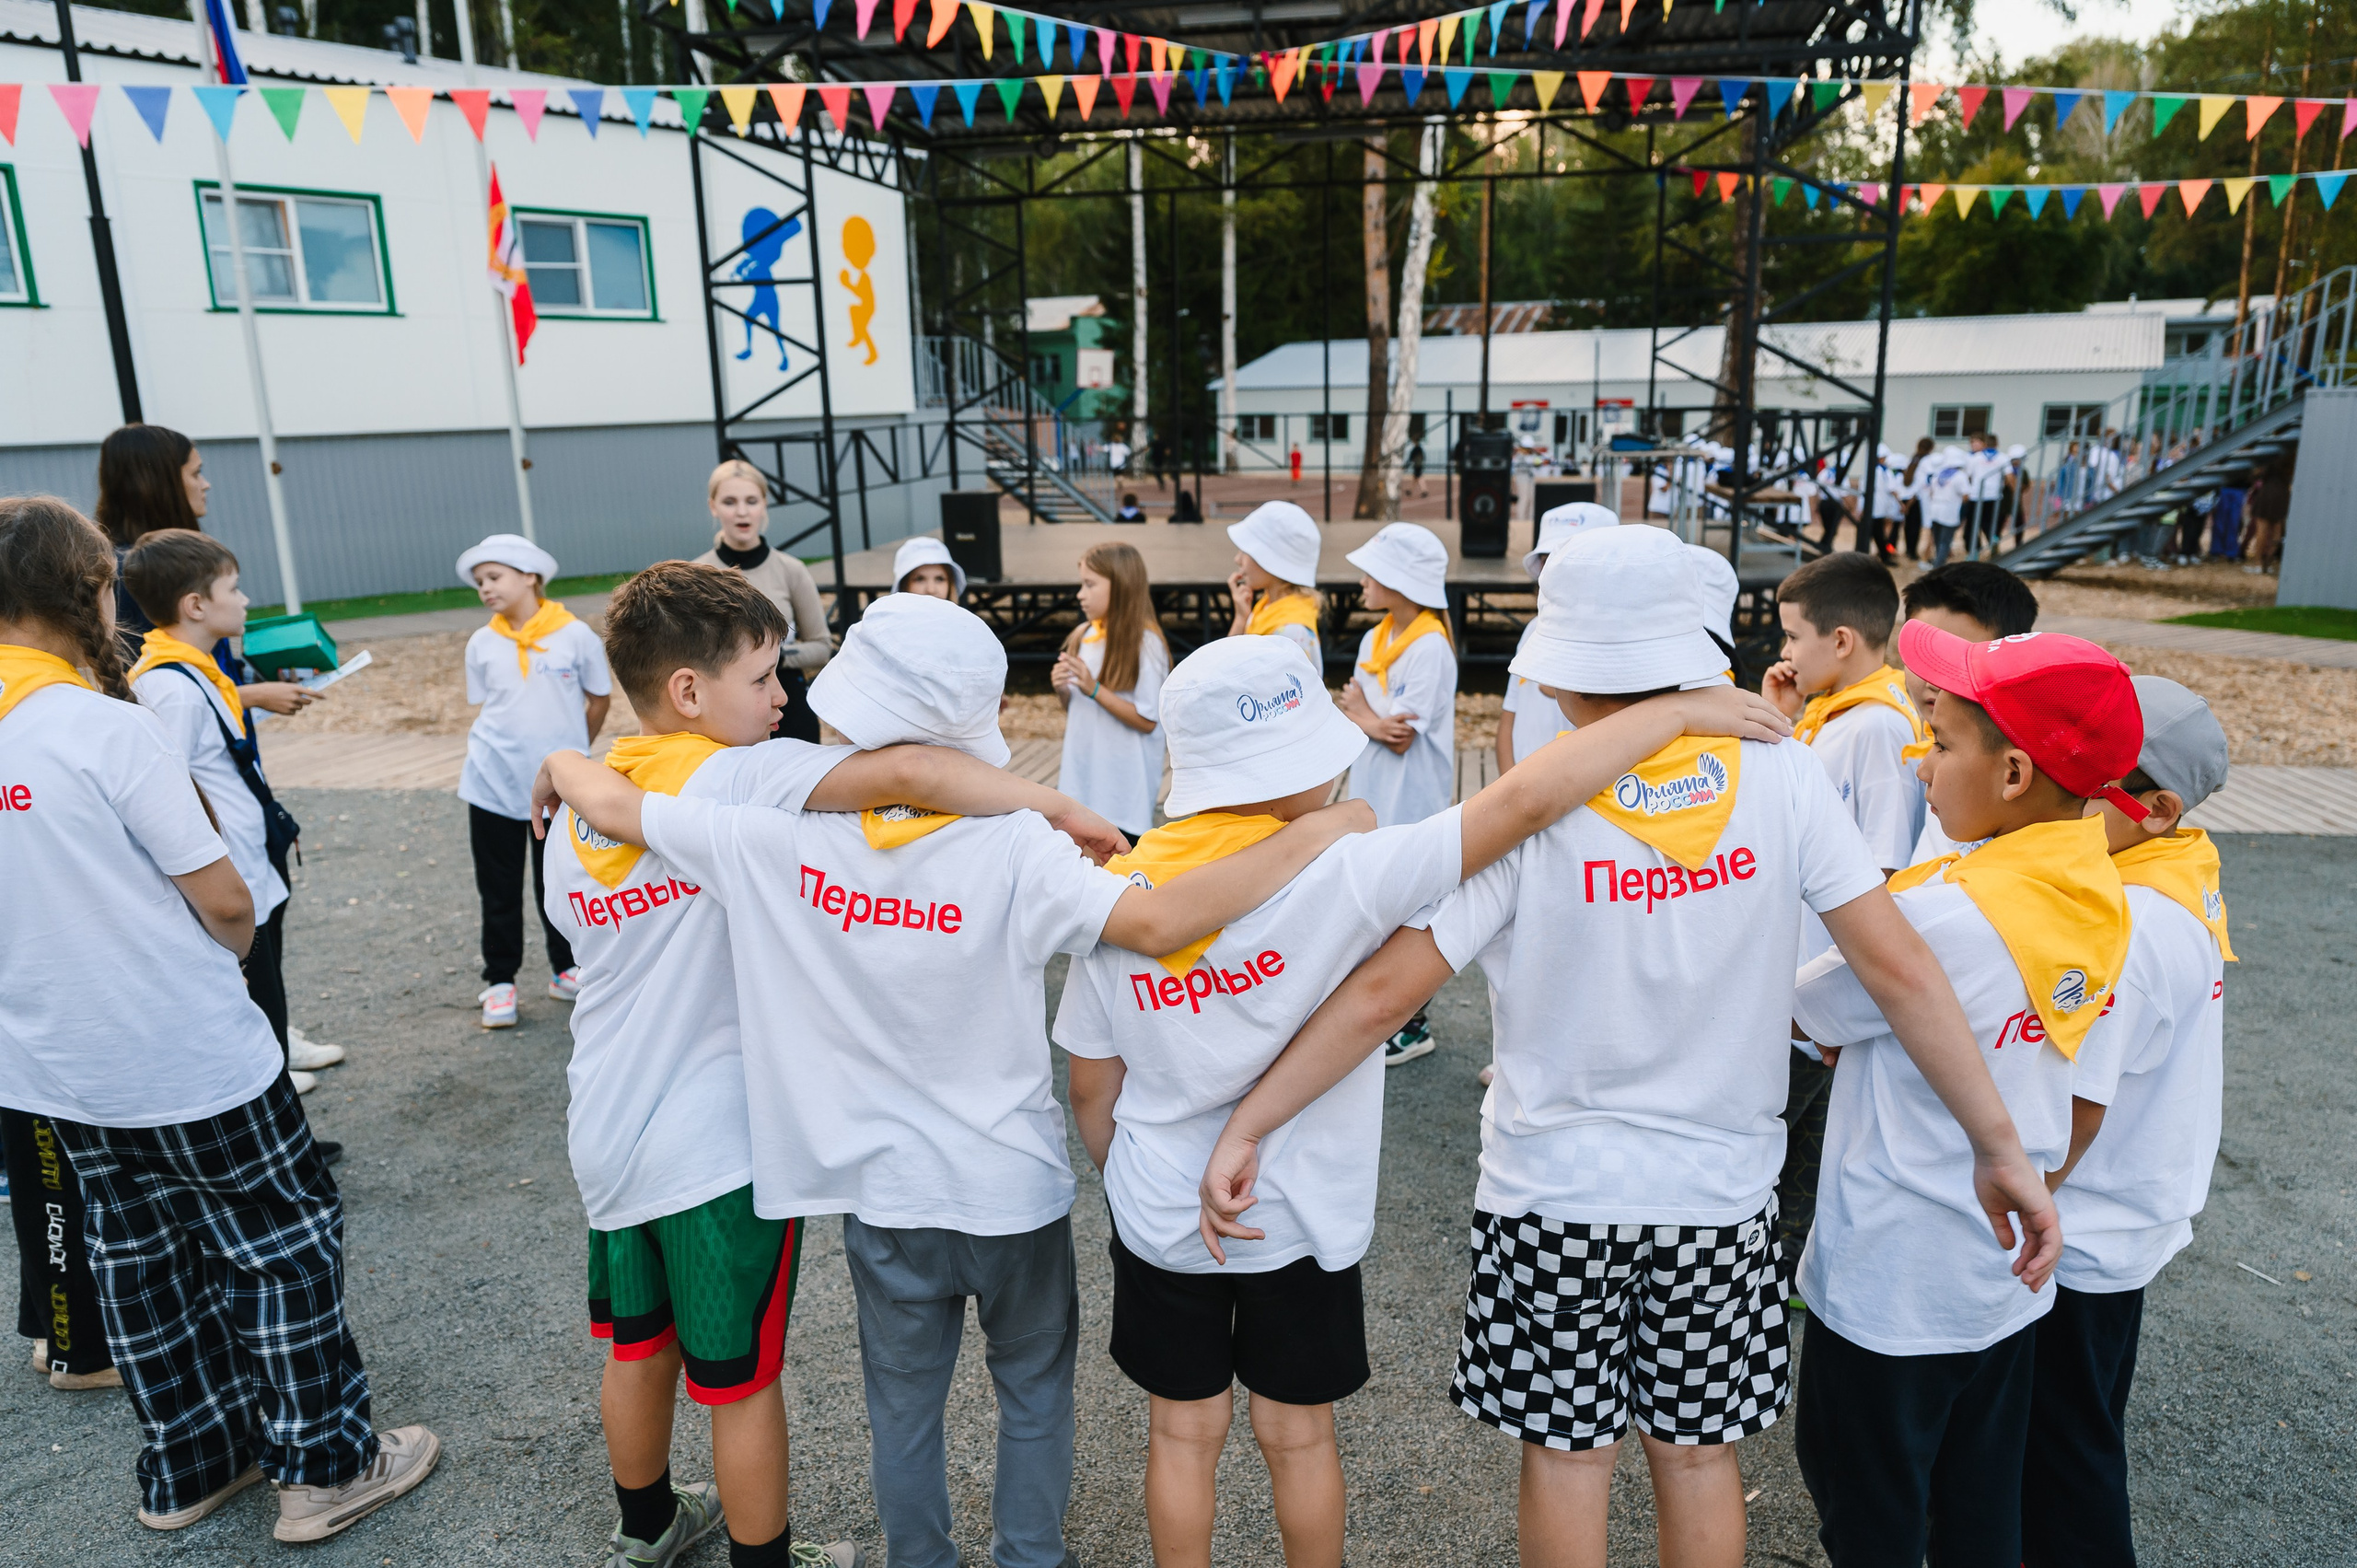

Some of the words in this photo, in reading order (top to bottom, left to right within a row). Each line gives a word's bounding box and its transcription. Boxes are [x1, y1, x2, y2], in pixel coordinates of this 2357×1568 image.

[1616, 775, 1711, 809] Орлята
[1650, 789, 1715, 814] РОССИИ
[800, 865, 962, 934] Первые
